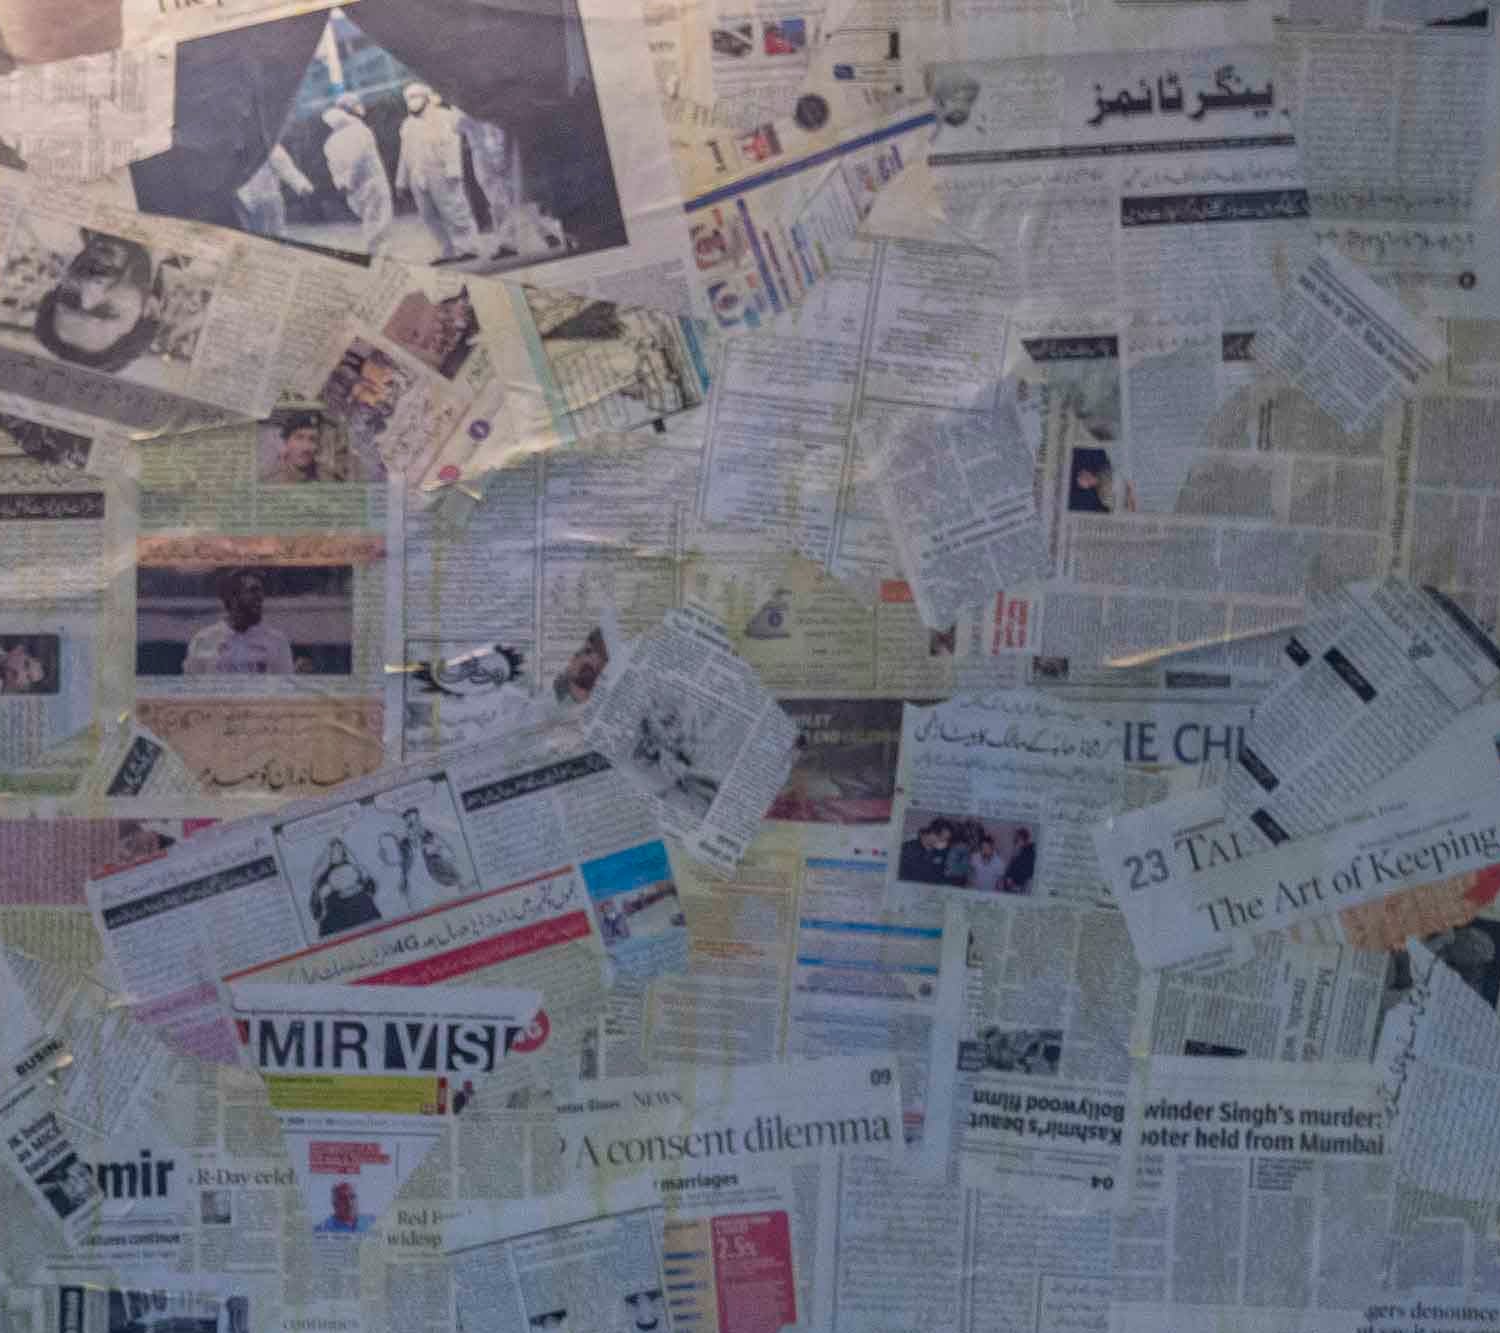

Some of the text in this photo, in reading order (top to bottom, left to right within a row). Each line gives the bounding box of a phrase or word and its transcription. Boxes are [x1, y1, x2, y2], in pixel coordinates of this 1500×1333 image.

[1124, 851, 1170, 886] 23
[1199, 892, 1267, 933] The
[1268, 874, 1325, 911] Art
[1329, 858, 1367, 891] of
[1369, 819, 1500, 889] Keeping
[257, 1018, 369, 1070] MIR
[869, 1067, 891, 1085] 09
[1026, 1093, 1125, 1122] Bollywood
[1218, 1102, 1295, 1130] Singh's
[1299, 1106, 1384, 1130] murder:
[604, 1123, 734, 1164] consent
[743, 1107, 891, 1154] dilemma
[1028, 1116, 1122, 1146] Kashmir's
[1194, 1126, 1240, 1150] held
[1244, 1128, 1295, 1152] from
[1299, 1132, 1384, 1156] Mumbai
[1090, 1173, 1115, 1190] 04
[397, 1209, 428, 1226] Red
[1409, 1302, 1499, 1323] denounce
